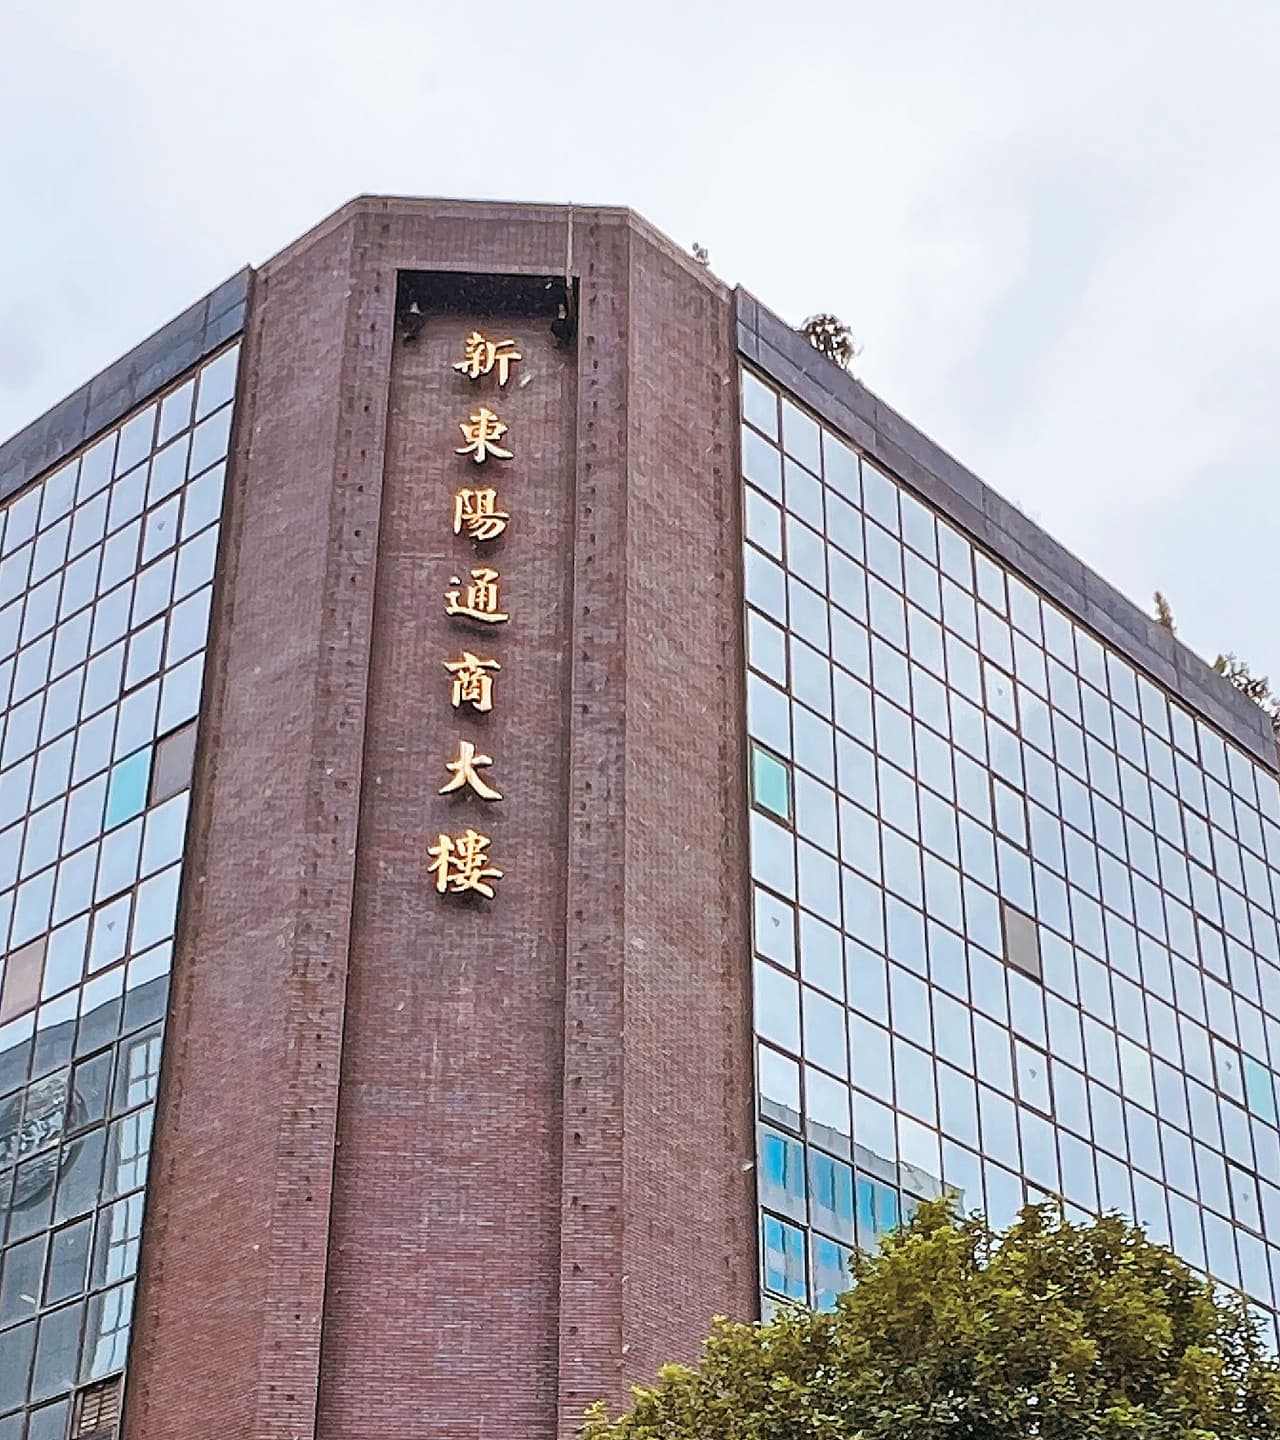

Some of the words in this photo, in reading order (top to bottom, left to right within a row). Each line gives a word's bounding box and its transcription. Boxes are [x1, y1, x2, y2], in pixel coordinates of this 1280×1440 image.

[427, 331, 521, 898] 新東陽通商大樓
